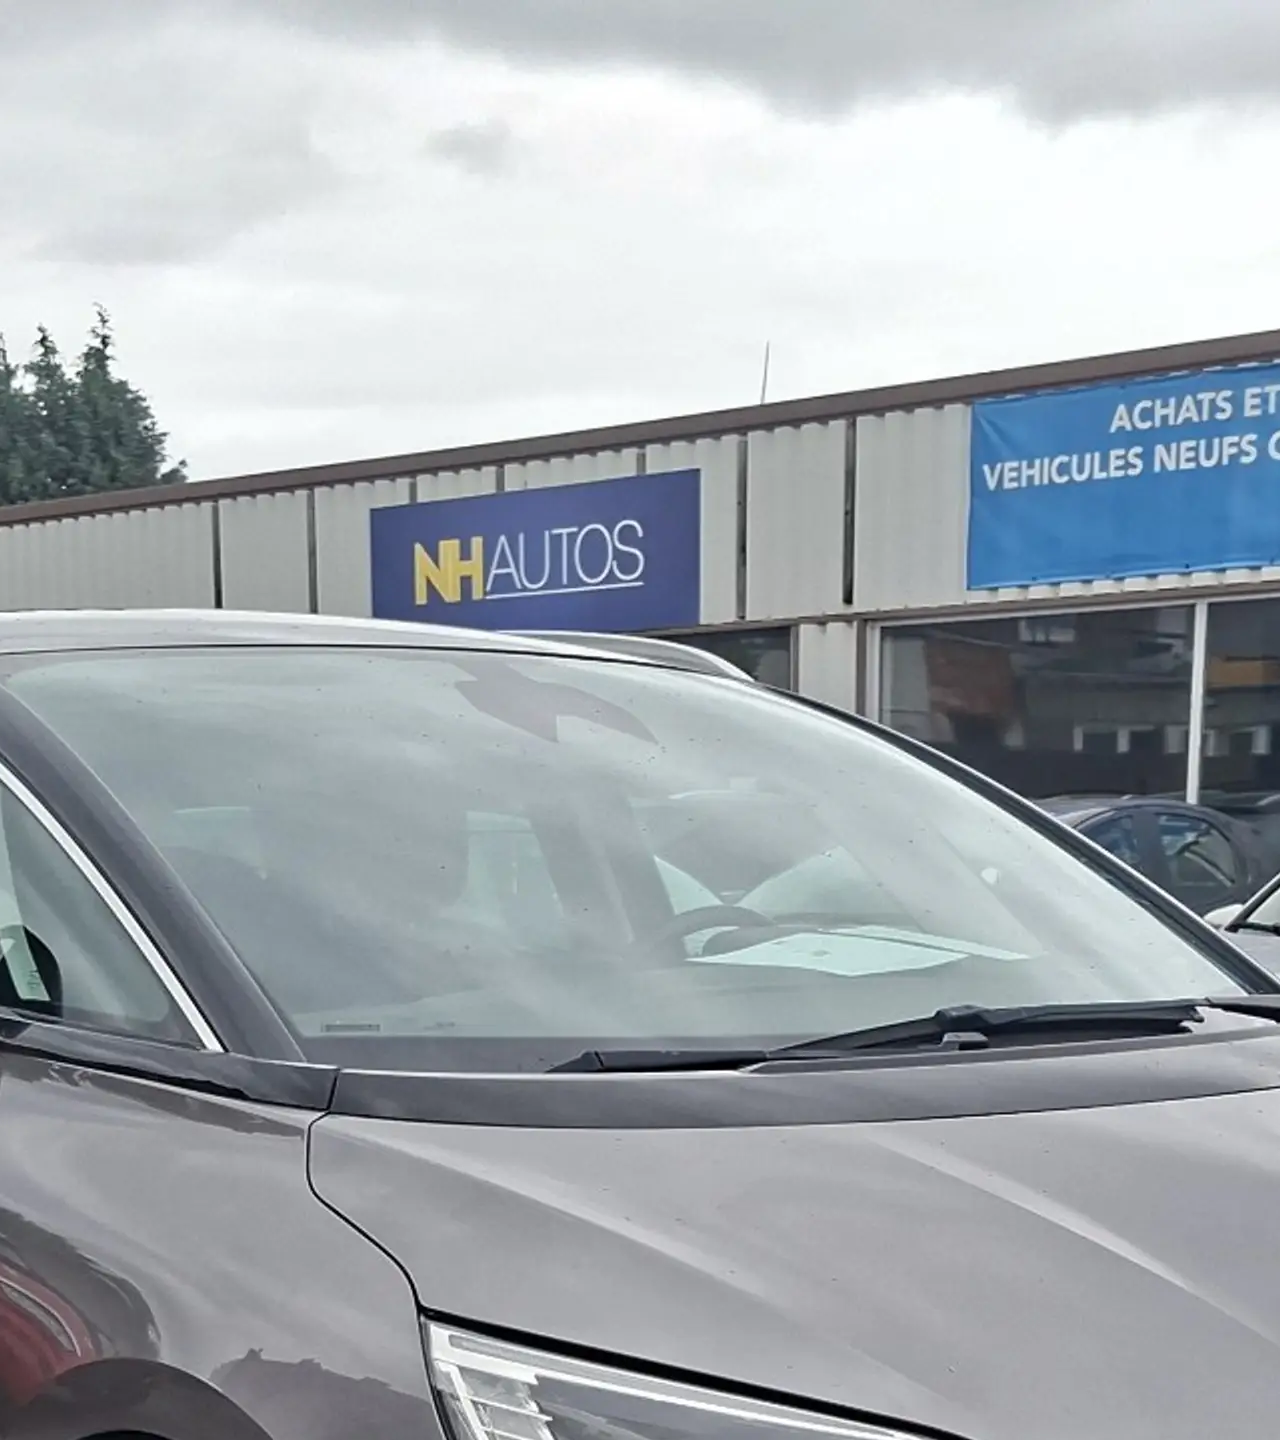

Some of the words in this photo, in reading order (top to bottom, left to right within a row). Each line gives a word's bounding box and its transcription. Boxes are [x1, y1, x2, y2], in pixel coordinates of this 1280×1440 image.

[1109, 390, 1234, 433] ACHATS
[981, 442, 1144, 492] VEHICULES
[1152, 433, 1258, 473] NEUFS
